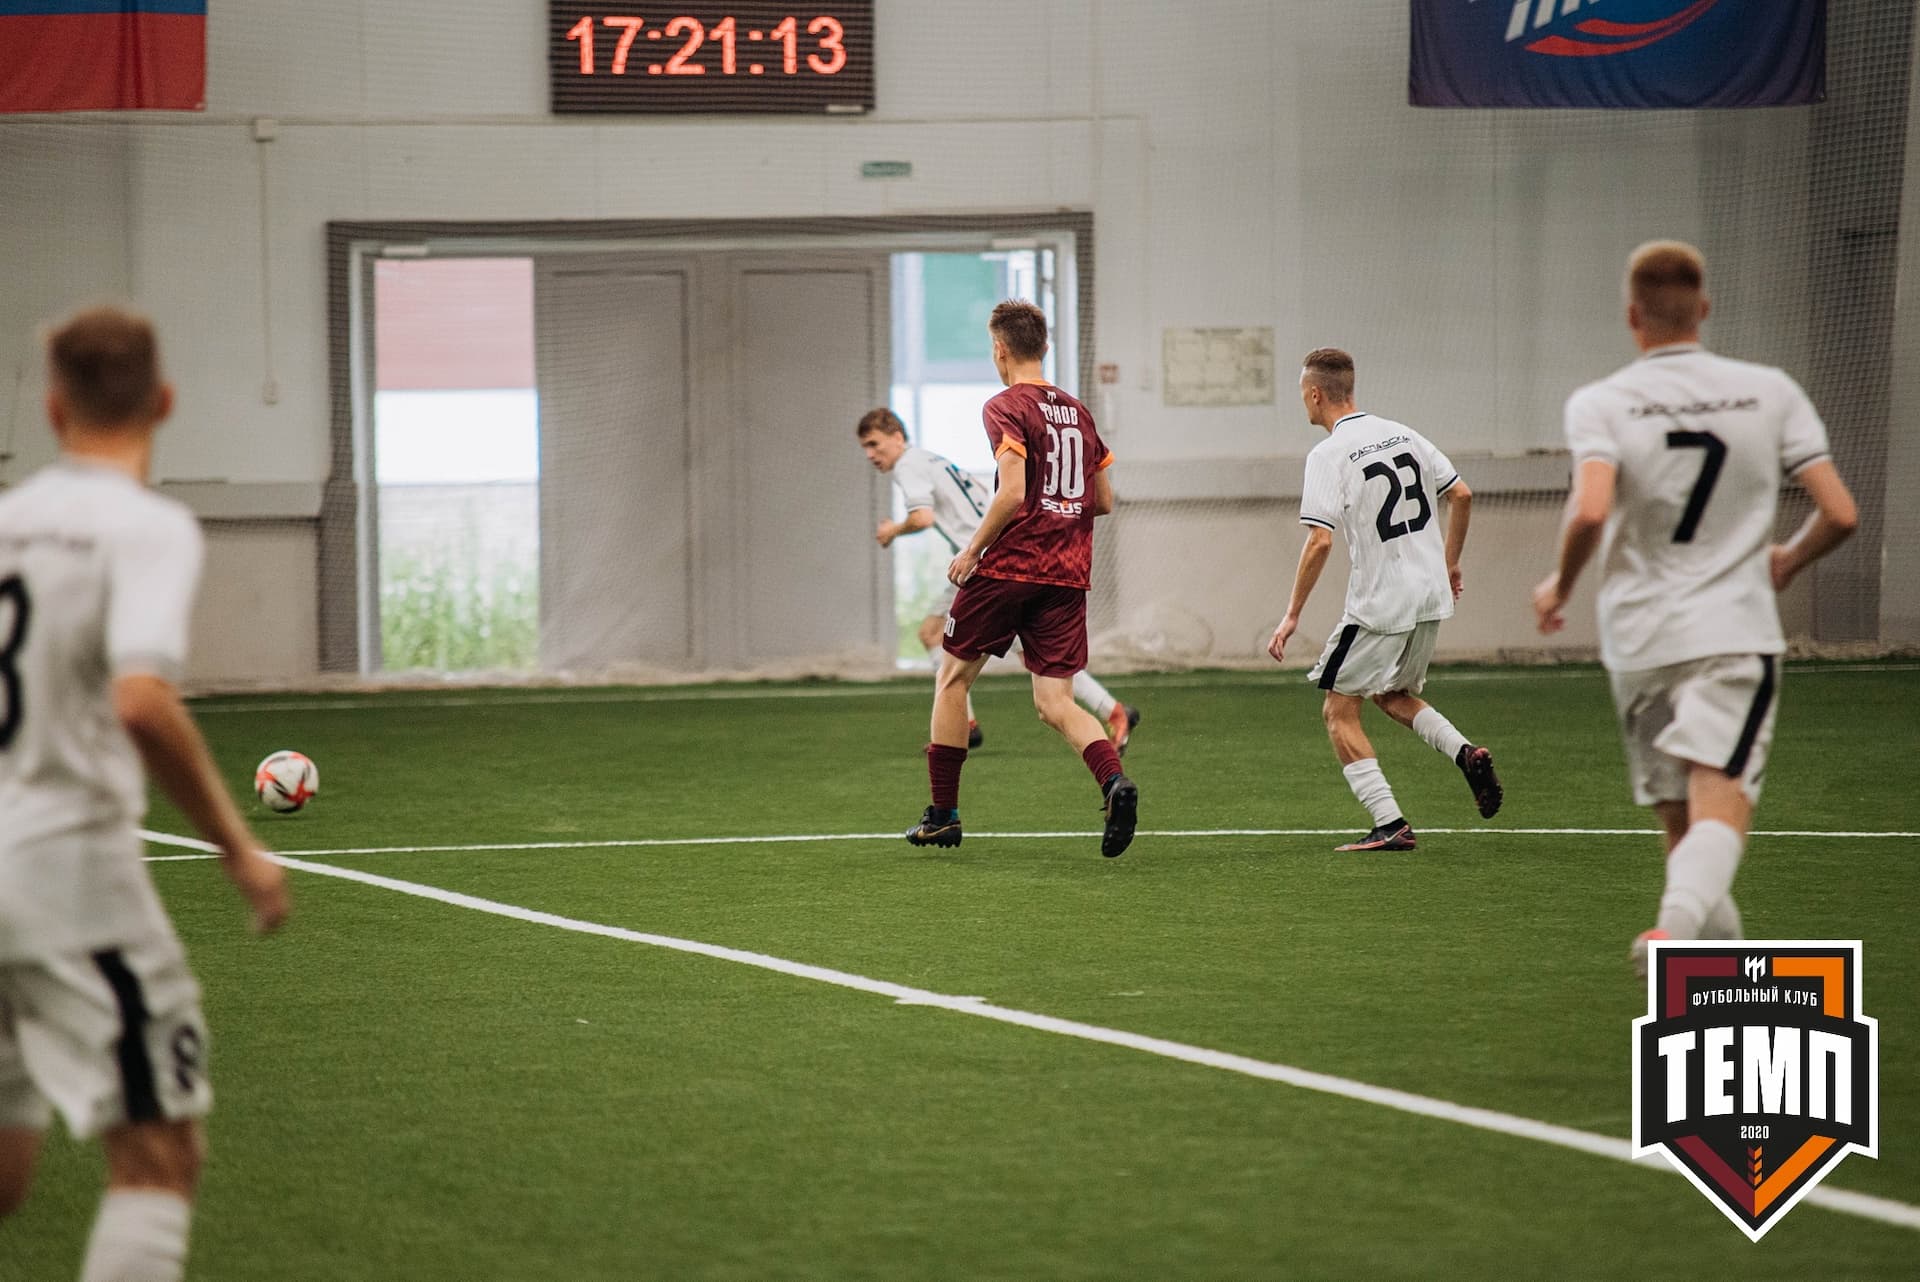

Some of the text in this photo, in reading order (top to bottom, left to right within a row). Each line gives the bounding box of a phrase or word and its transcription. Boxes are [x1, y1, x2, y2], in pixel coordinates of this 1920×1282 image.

[566, 16, 848, 75] 17:21:13
[1043, 423, 1085, 499] 30
[1362, 452, 1432, 543] 23
[1665, 430, 1728, 544] 7
